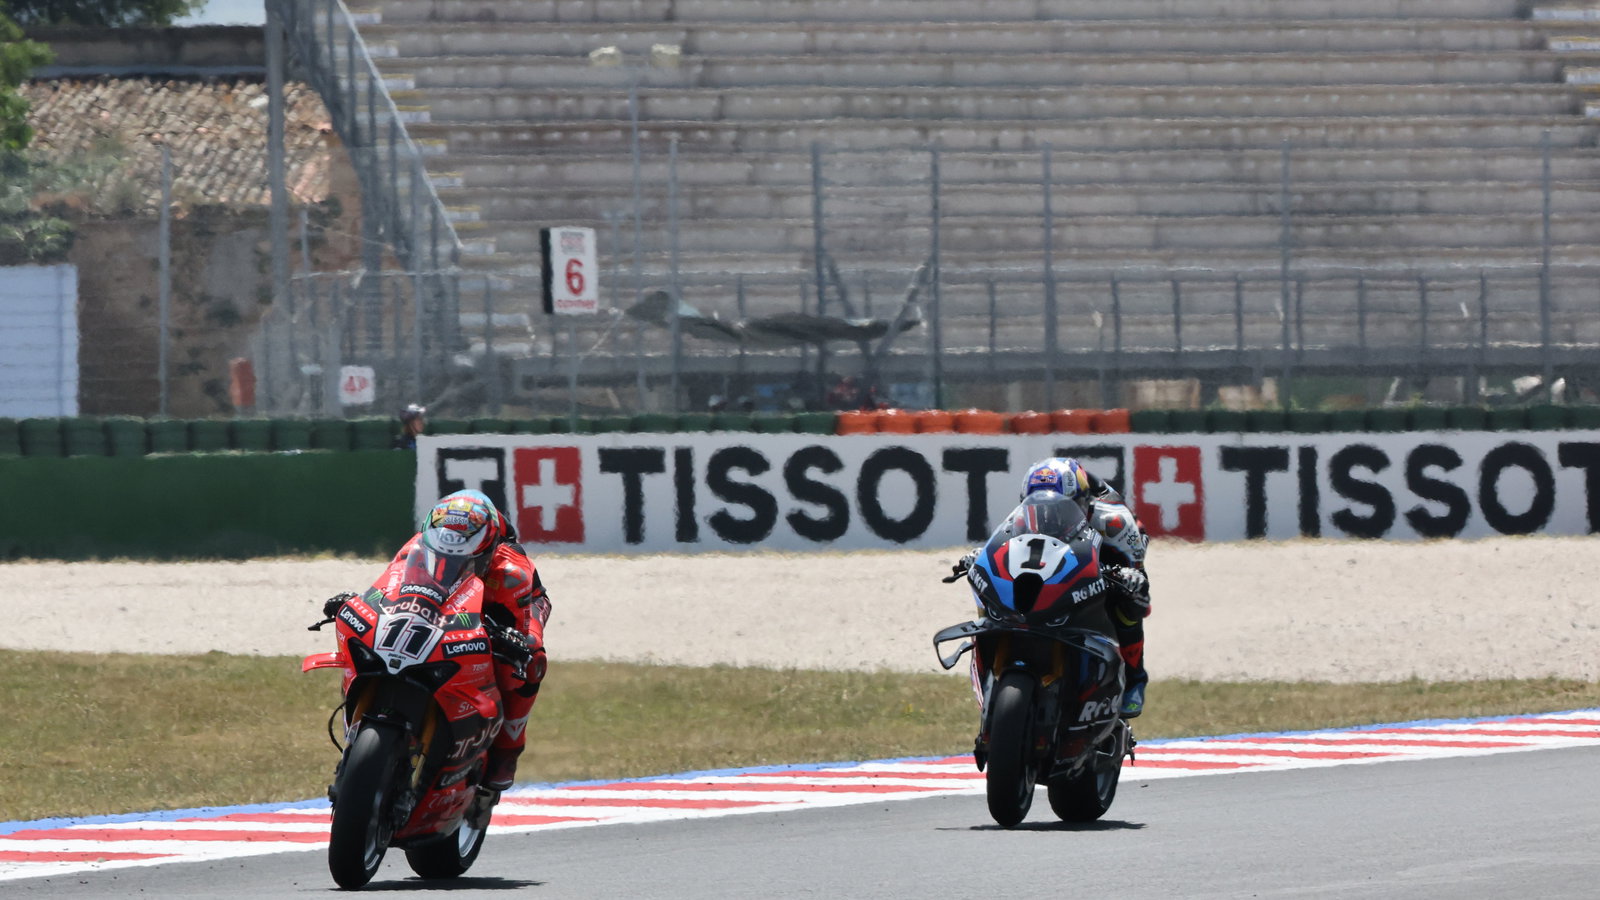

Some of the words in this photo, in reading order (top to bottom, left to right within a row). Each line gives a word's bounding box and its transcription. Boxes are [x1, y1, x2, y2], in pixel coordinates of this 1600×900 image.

[565, 258, 585, 296] 6
[598, 445, 1010, 544] TISSOT
[1021, 538, 1047, 570] 1
[401, 584, 443, 603] CARRERA
[339, 606, 367, 633] Lenovo
[384, 596, 448, 627] aruba.it
[382, 616, 436, 658] 11
[443, 630, 485, 642] ALTEN
[445, 641, 487, 655] Lenovo
